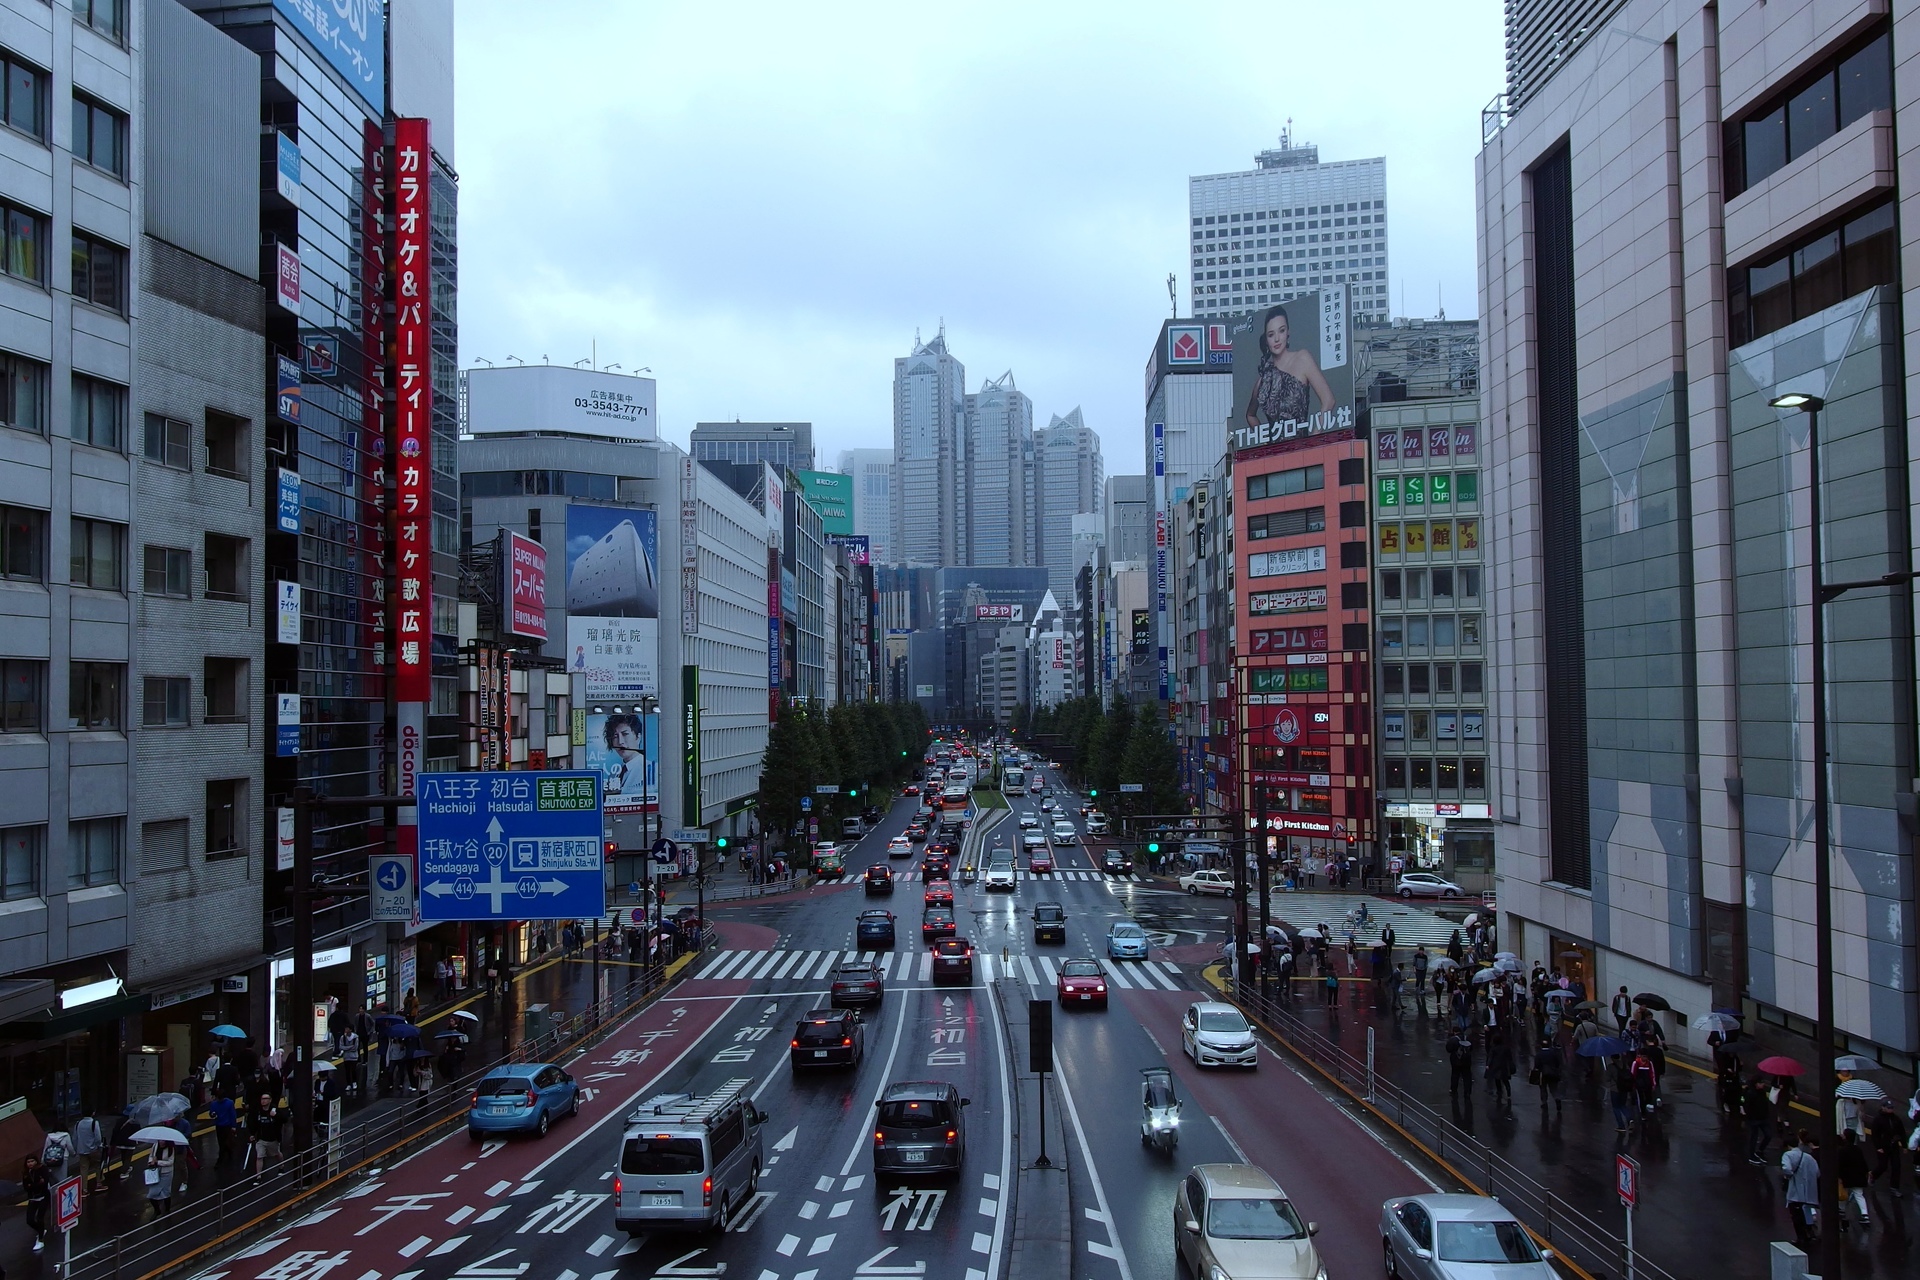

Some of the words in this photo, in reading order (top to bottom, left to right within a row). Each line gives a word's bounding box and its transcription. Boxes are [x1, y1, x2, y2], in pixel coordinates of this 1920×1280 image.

[1334, 292, 1342, 361] 世界の不動産を
[591, 390, 633, 403] 広告募集中
[574, 397, 648, 416] 03-3543-7771
[585, 408, 637, 422] www.hit-ad.co.jp
[1235, 405, 1351, 447] THEグローバル社
[1382, 476, 1446, 492] ほぐし
[280, 501, 300, 516] イーオン
[823, 507, 846, 518] MIWA
[1156, 520, 1165, 547] LABI
[1381, 528, 1450, 549] 占い館
[515, 547, 532, 566] SUPER
[1269, 550, 1305, 564] 新宿駅前
[1313, 549, 1320, 568] 歯科
[1157, 550, 1166, 589] SHINJUKU
[1256, 562, 1307, 576] デンタルクリニック
[1270, 595, 1325, 608] エーアイアール
[979, 606, 1009, 616] やまや
[587, 628, 641, 642] 瑠璃光院
[771, 629, 779, 649] JAPAN
[1255, 629, 1306, 650] アコム
[1313, 628, 1324, 638] 6F
[771, 650, 779, 668] TOTAL
[771, 669, 779, 684] CLUB
[1258, 674, 1285, 687] レイク
[424, 779, 481, 800] 八王子
[490, 777, 530, 799] 初台
[540, 779, 593, 798] 首都高
[429, 802, 476, 815] Hachioji
[488, 801, 533, 813] Hatsudai
[540, 799, 577, 809] SHUTOKO
[578, 798, 594, 809] EXP
[1284, 820, 1300, 829] First
[1301, 821, 1329, 831] Kitchen
[424, 838, 479, 860] 千駄ヶ谷
[541, 840, 597, 857] 新宿駅西口
[488, 846, 503, 859] 20
[425, 862, 479, 875] Sendagaya
[541, 858, 573, 869] Shinjuku
[456, 882, 472, 893] 414
[520, 882, 535, 893] 414
[315, 954, 334, 964] SELECT
[711, 1026, 774, 1063] 初台
[927, 1028, 966, 1066] 初台
